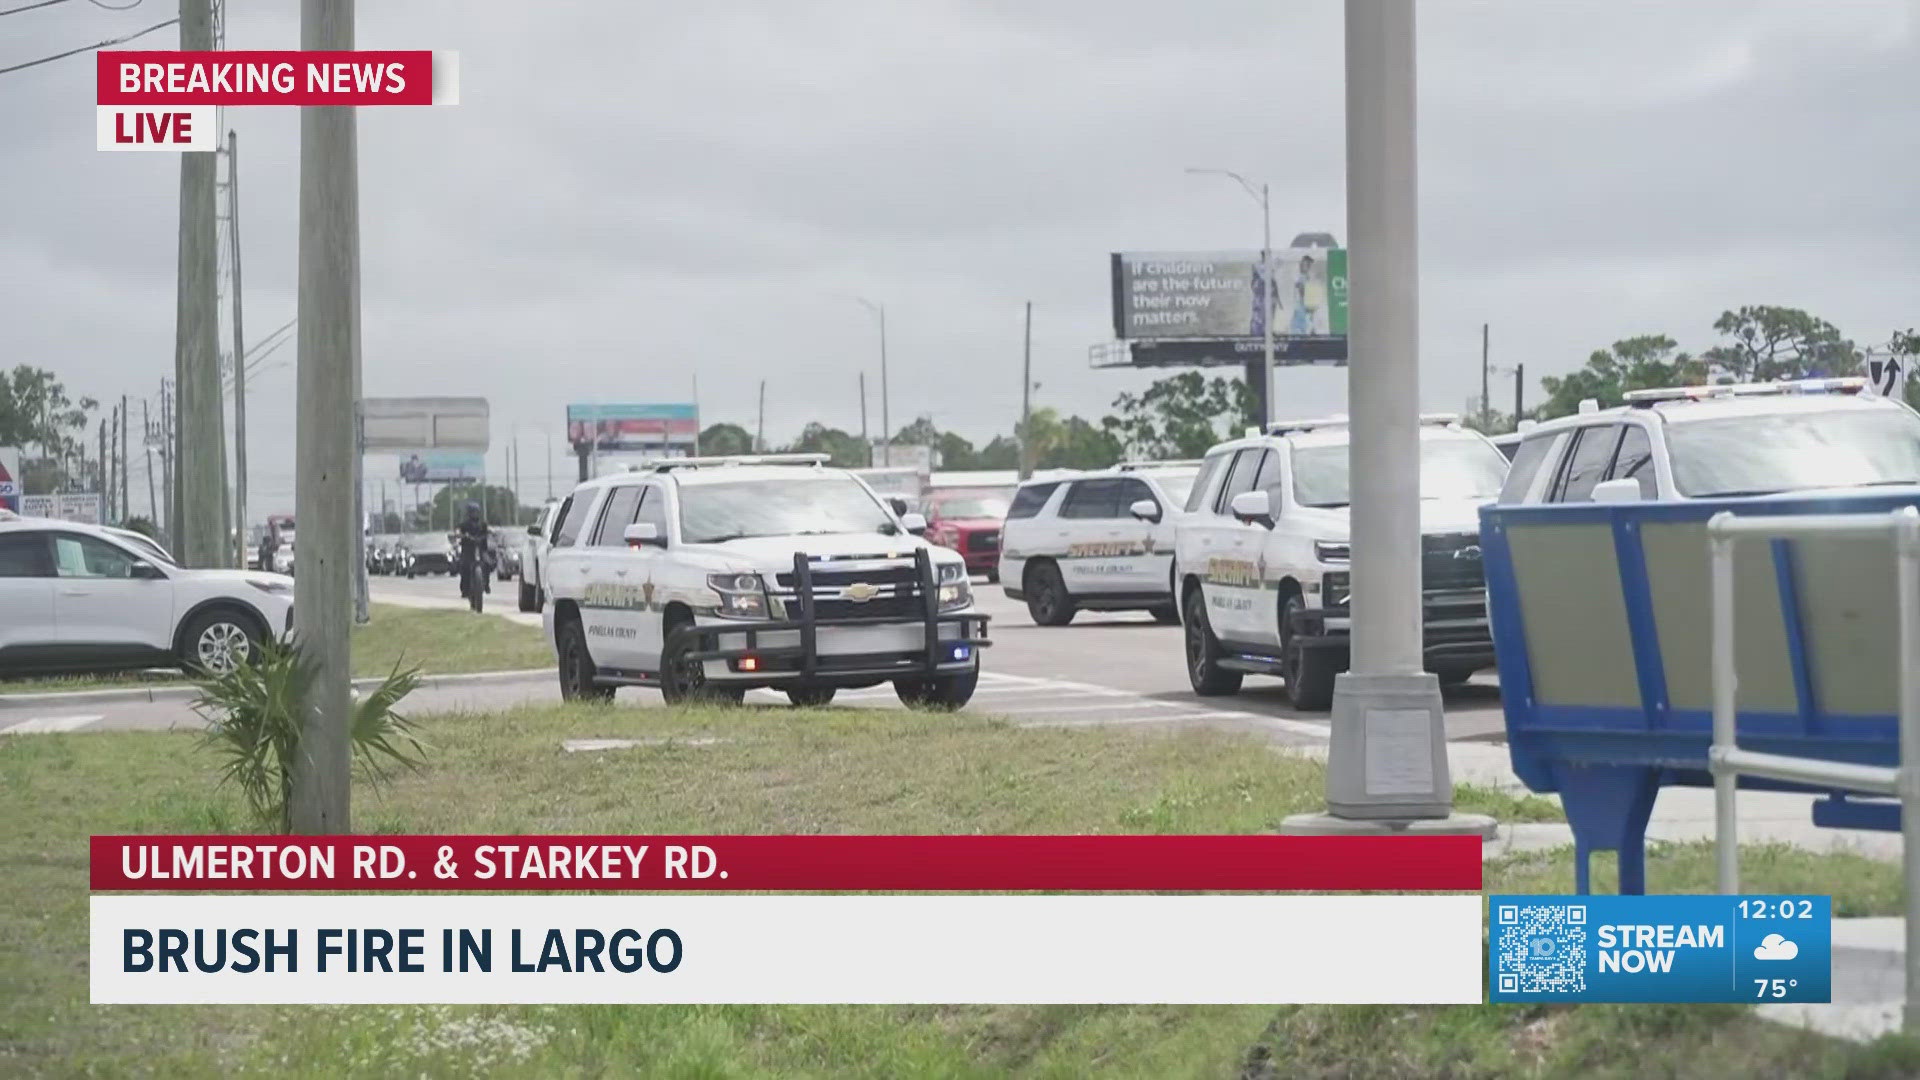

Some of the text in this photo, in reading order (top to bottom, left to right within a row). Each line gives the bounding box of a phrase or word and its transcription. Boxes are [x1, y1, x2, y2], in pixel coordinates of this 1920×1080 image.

[1131, 261, 1214, 275] If children
[1132, 277, 1243, 291] are the future
[1132, 294, 1210, 308] their now
[1067, 541, 1137, 558] SHERIFF
[1208, 558, 1254, 586] SHERIFF
[585, 583, 638, 608] SHERIFF
[615, 627, 637, 639] COUNTY
